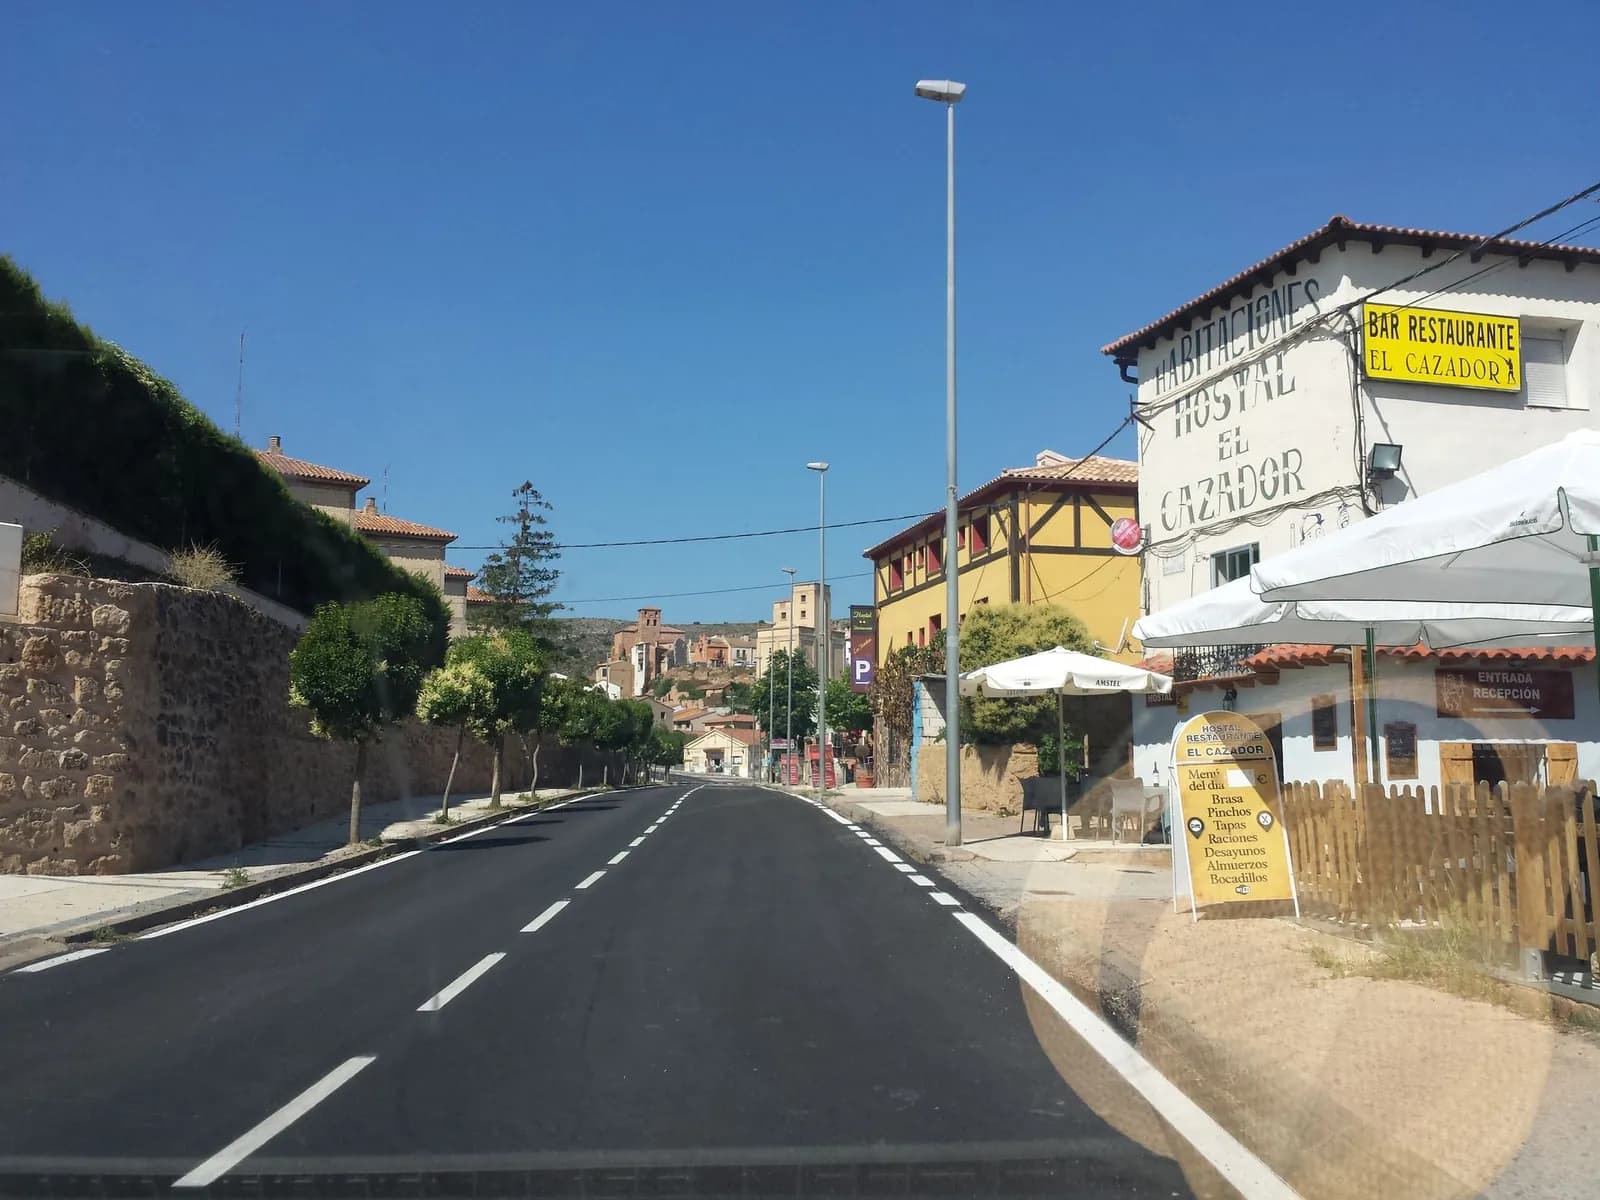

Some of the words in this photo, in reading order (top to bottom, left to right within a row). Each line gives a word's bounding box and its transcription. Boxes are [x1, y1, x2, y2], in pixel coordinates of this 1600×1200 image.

[1156, 278, 1321, 395] HABITACIONES
[1369, 311, 1399, 340] BAR
[1409, 315, 1515, 351] RESTAURANTE
[1370, 349, 1392, 372] EL
[1405, 352, 1500, 384] CAZADOR
[1175, 352, 1296, 438] HOSTAL
[1218, 425, 1249, 462] EL
[1161, 448, 1305, 531] CAZADOR
[855, 660, 871, 680] P
[1095, 679, 1121, 687] AMSTEL
[1478, 671, 1533, 684] ENTRADA
[1473, 686, 1540, 699] RECEPCIÓN
[1187, 748, 1201, 756] EL
[1206, 745, 1264, 756] CAZADOR
[1189, 781, 1206, 791] del
[1212, 794, 1243, 804] Brasa
[1208, 807, 1251, 817] Pinchos
[1213, 820, 1246, 834] Tapas
[1208, 834, 1258, 844] Raciones
[1204, 847, 1266, 859] Desayunos
[1207, 861, 1268, 871] Almuerzos
[1211, 873, 1268, 884] Bocadillos
